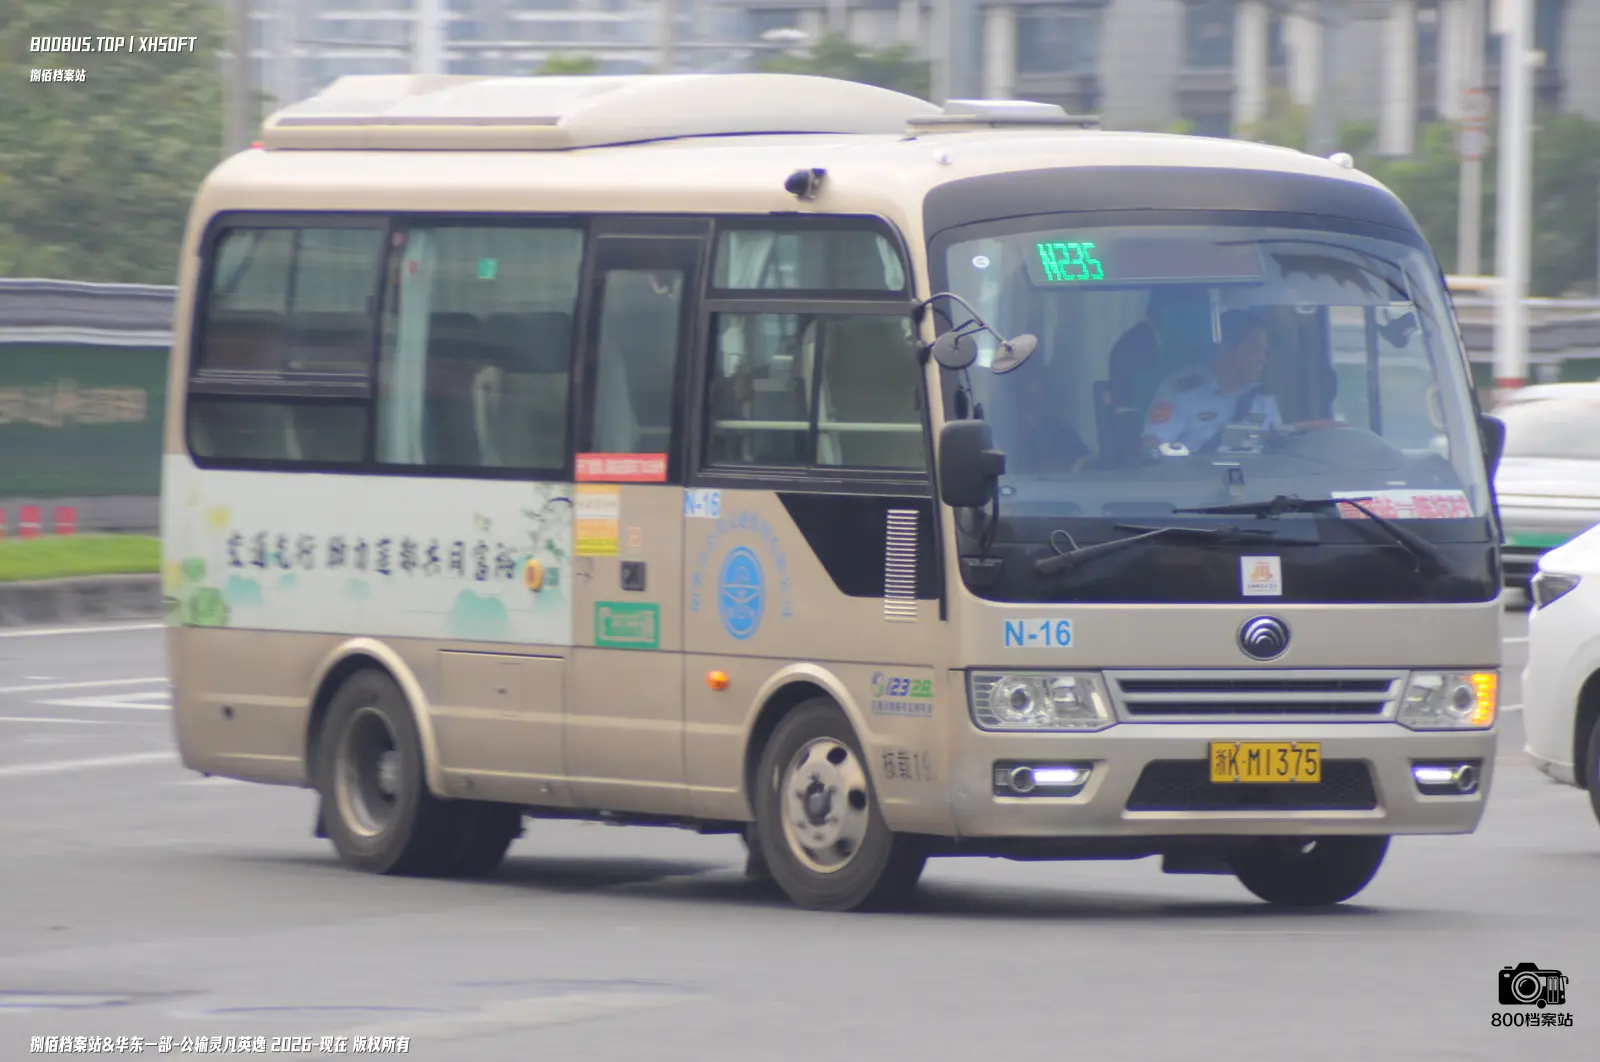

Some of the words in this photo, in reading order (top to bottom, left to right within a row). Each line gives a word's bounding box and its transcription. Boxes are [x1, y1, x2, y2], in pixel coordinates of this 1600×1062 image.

[1037, 242, 1104, 281] N235
[684, 490, 720, 517] N-16
[1004, 619, 1072, 647] N-16
